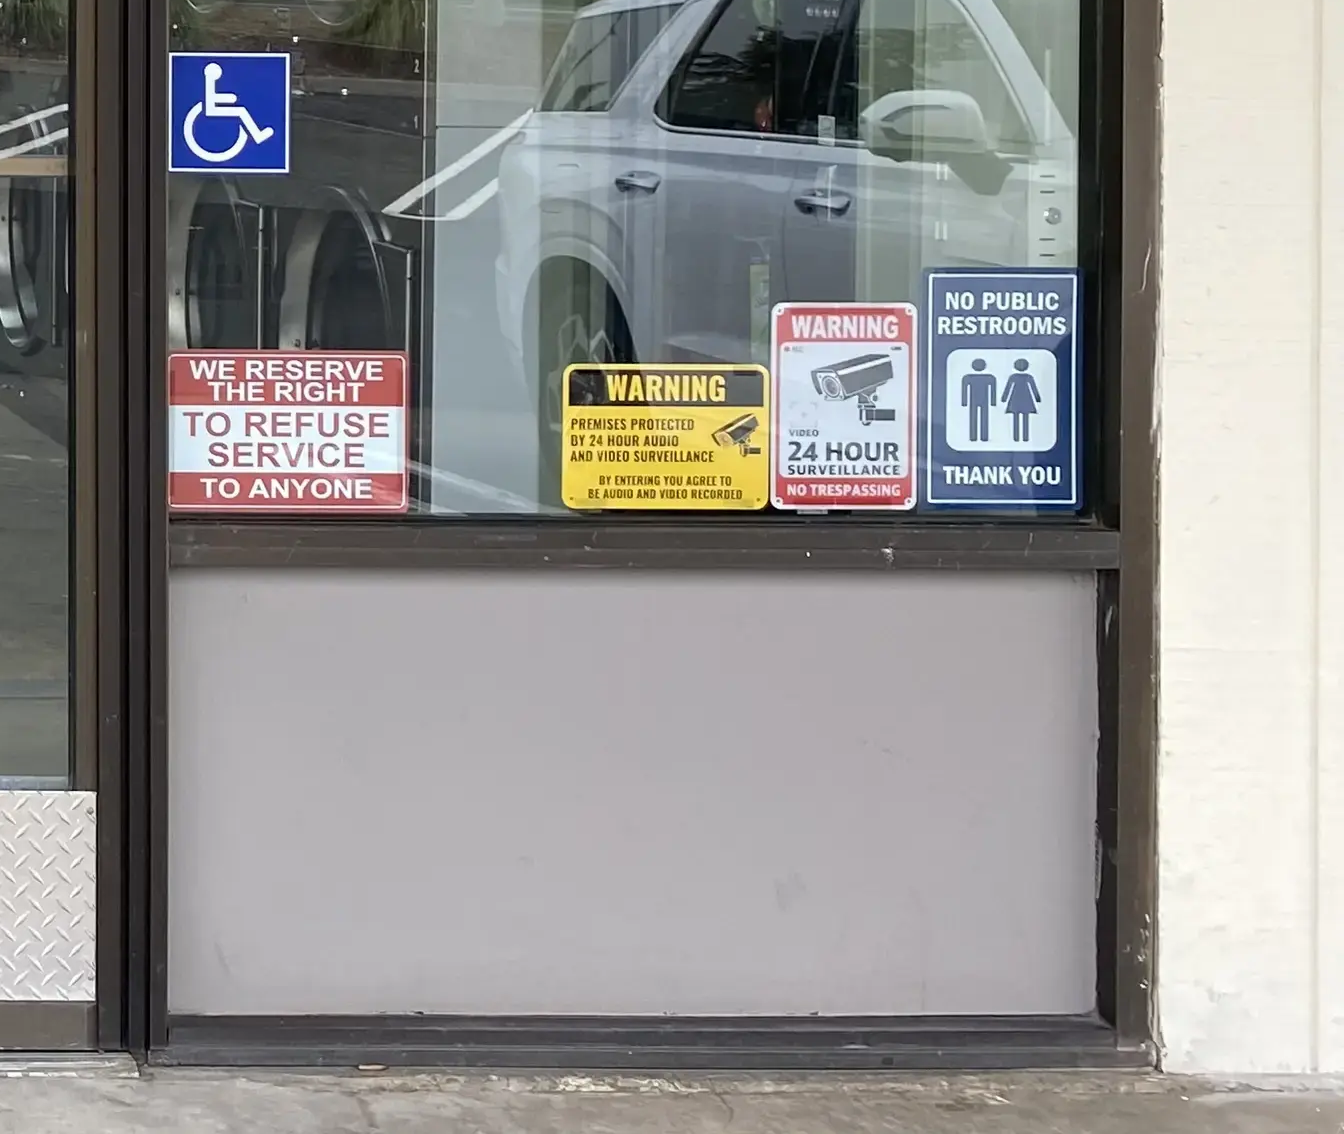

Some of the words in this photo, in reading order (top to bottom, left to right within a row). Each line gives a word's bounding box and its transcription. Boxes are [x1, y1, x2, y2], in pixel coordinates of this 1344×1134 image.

[944, 291, 975, 312] NO
[981, 291, 1060, 312] PUBLIC
[791, 315, 899, 339] WARNING
[937, 315, 1067, 336] RESTROOMS
[189, 359, 241, 382] WE
[245, 359, 384, 382] RESERVE
[207, 381, 264, 403] THE
[274, 381, 365, 403] RIGHT
[606, 374, 726, 402] WARNING
[183, 411, 231, 438] TO
[244, 411, 390, 438] REFUSE
[571, 418, 627, 431] PREMISES
[631, 418, 695, 431] PROTECTED
[789, 429, 819, 437] VIDEO
[571, 435, 585, 447] BY
[589, 435, 603, 447] 24
[607, 435, 639, 447] HOUR
[643, 435, 679, 447] AUDIO
[788, 441, 818, 462] 24
[826, 441, 899, 462] HOUR
[207, 442, 366, 468] SERVICE
[570, 451, 593, 463] AND
[597, 451, 629, 463] VIDEO
[633, 451, 714, 463] SURVEILLANCE
[787, 464, 901, 476] SURVEILLANCE
[943, 466, 1014, 486] THANK
[1017, 466, 1062, 486] YOU
[200, 477, 241, 500] TO
[248, 477, 374, 500] ANYONE
[599, 476, 611, 486] BY
[615, 476, 660, 486] ENTERING
[664, 476, 682, 486] YOU
[686, 476, 718, 486] AGREE
[720, 476, 732, 486] TO
[787, 484, 807, 496] NO
[811, 484, 901, 496] TRESPASSING
[588, 489, 600, 500] BE
[603, 489, 633, 500] AUDIO
[637, 489, 656, 500] AND
[660, 489, 687, 500] VIDEO
[691, 489, 742, 500] RECORDED
